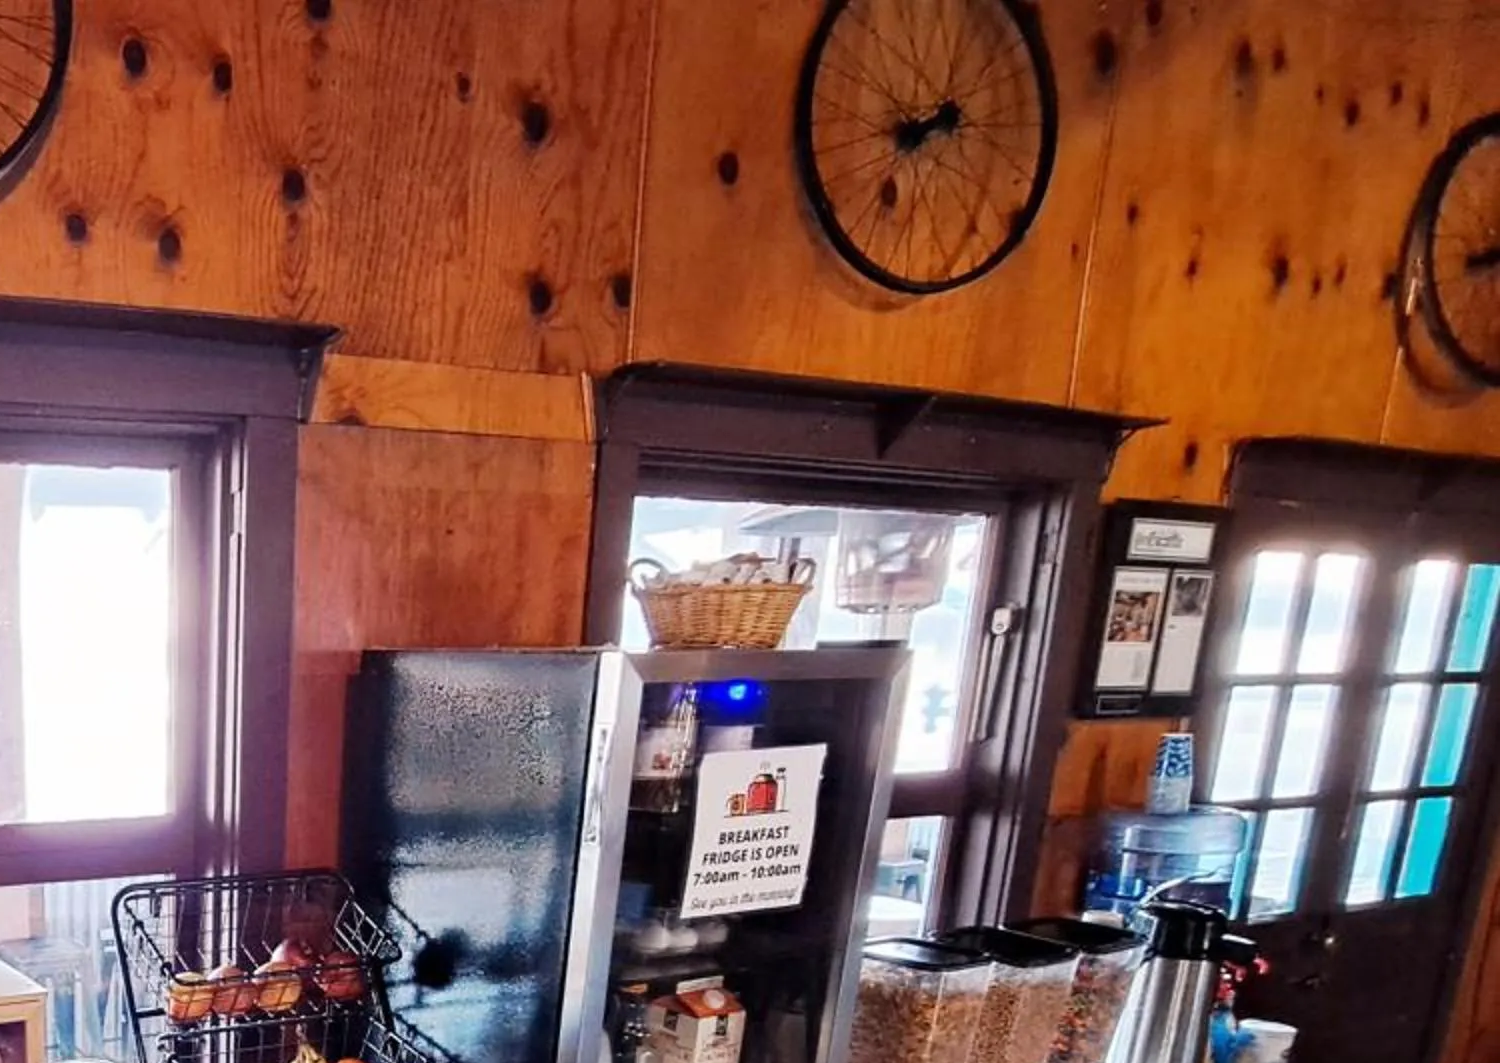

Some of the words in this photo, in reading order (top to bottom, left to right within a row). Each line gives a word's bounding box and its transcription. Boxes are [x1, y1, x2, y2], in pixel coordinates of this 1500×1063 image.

[718, 825, 790, 846] BREAKFAST
[702, 848, 749, 866] FRIDGE
[751, 847, 762, 861] IS
[765, 844, 801, 860] OPEN
[693, 870, 740, 887] 7:00am
[751, 863, 801, 880] 10:00am
